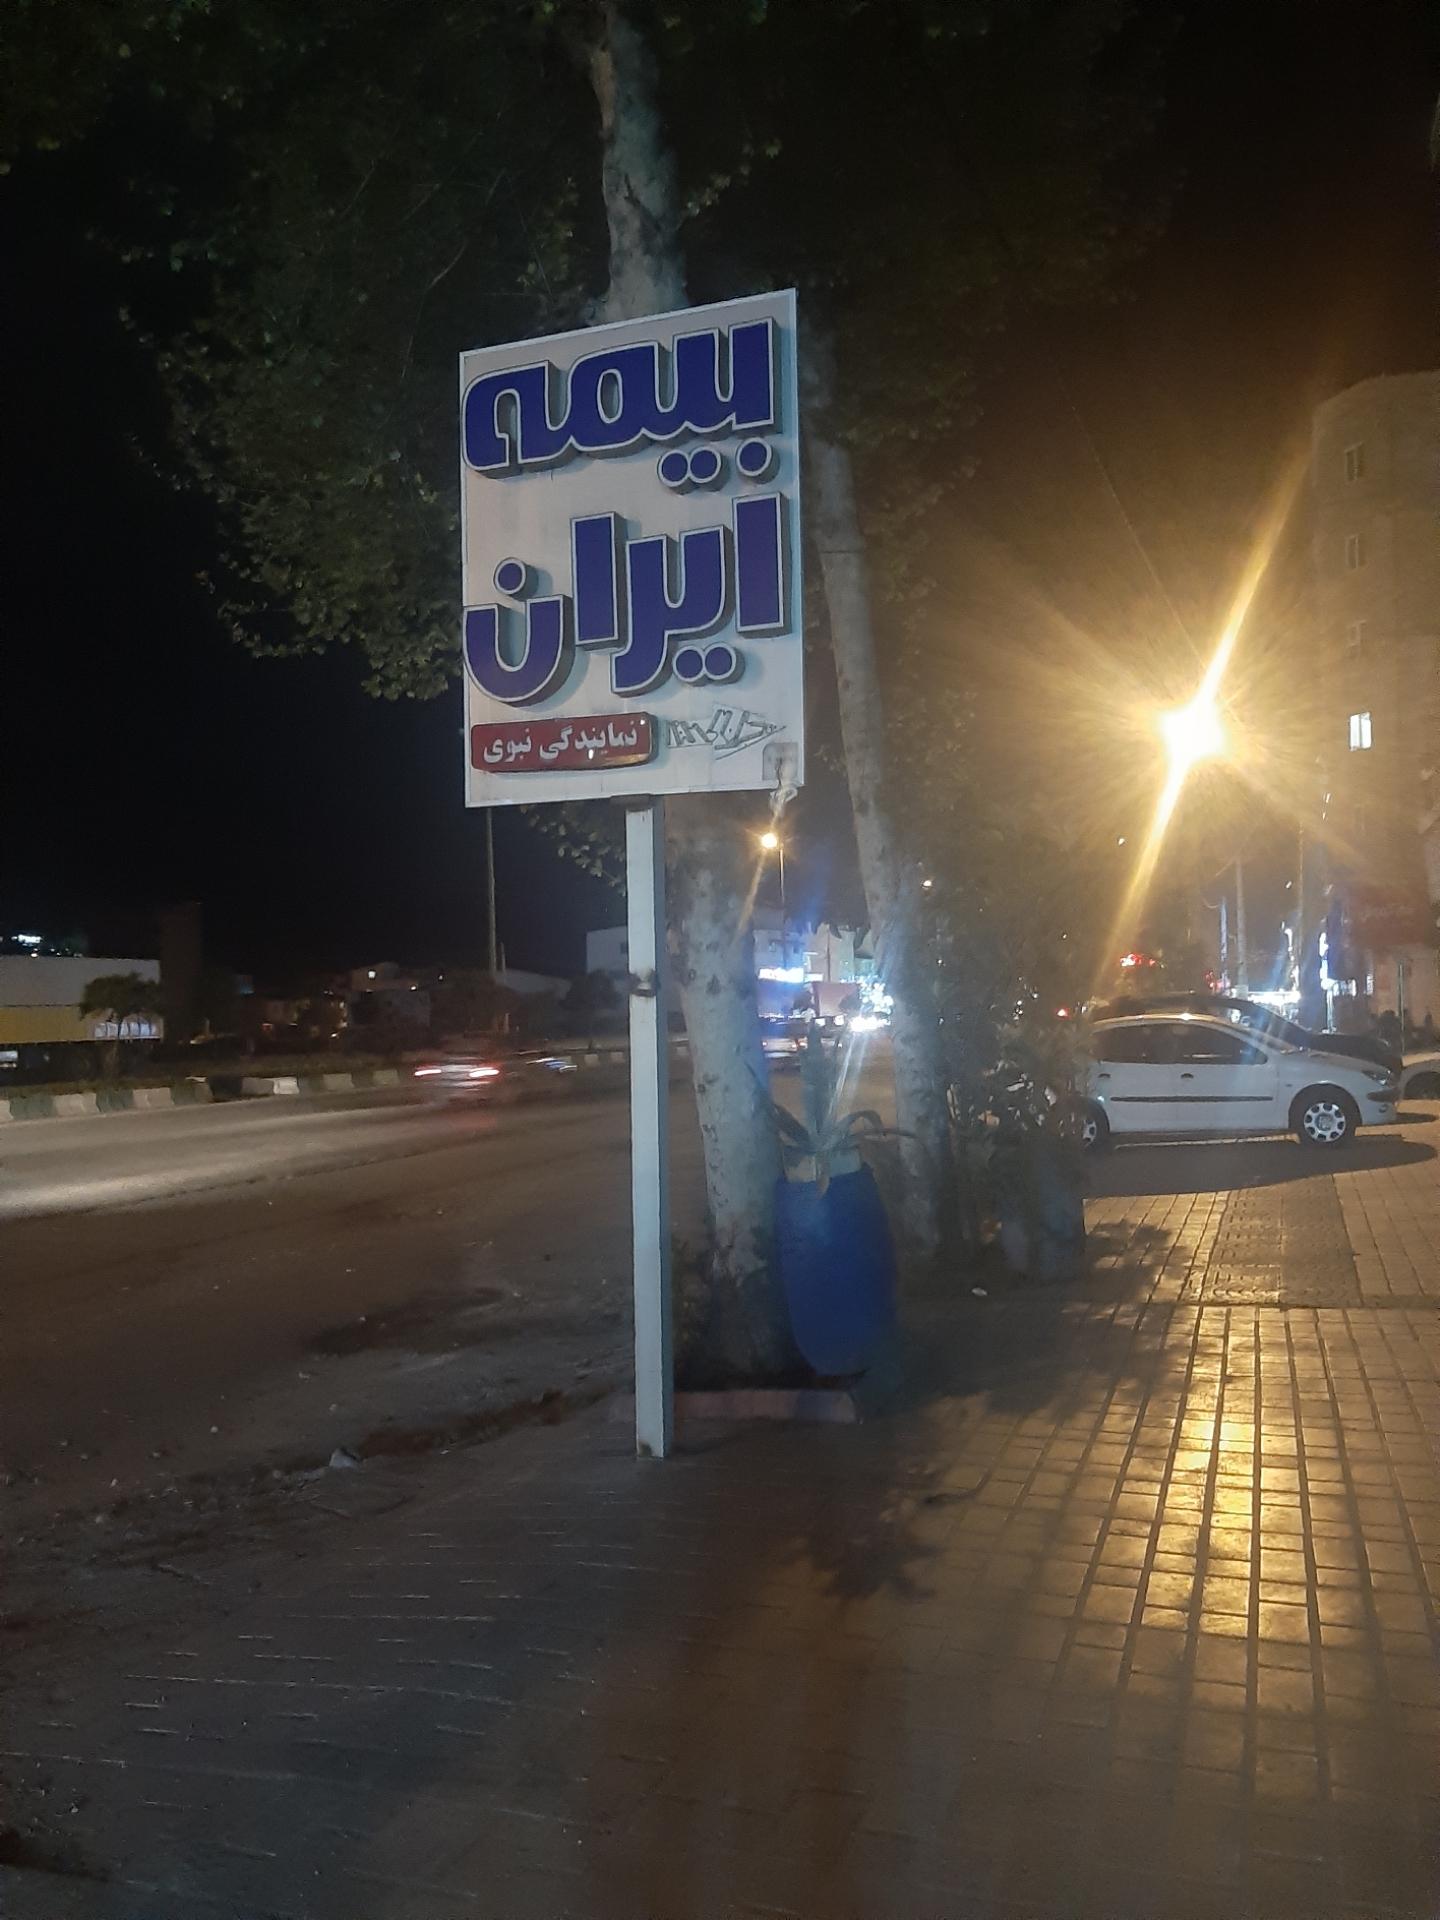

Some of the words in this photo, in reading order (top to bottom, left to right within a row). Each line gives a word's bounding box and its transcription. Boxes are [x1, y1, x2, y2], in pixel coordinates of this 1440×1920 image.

[462, 316, 775, 488] بیمه
[462, 492, 785, 703] ایران
[483, 727, 532, 764] نبوی
[539, 719, 638, 760] نمایندگی
